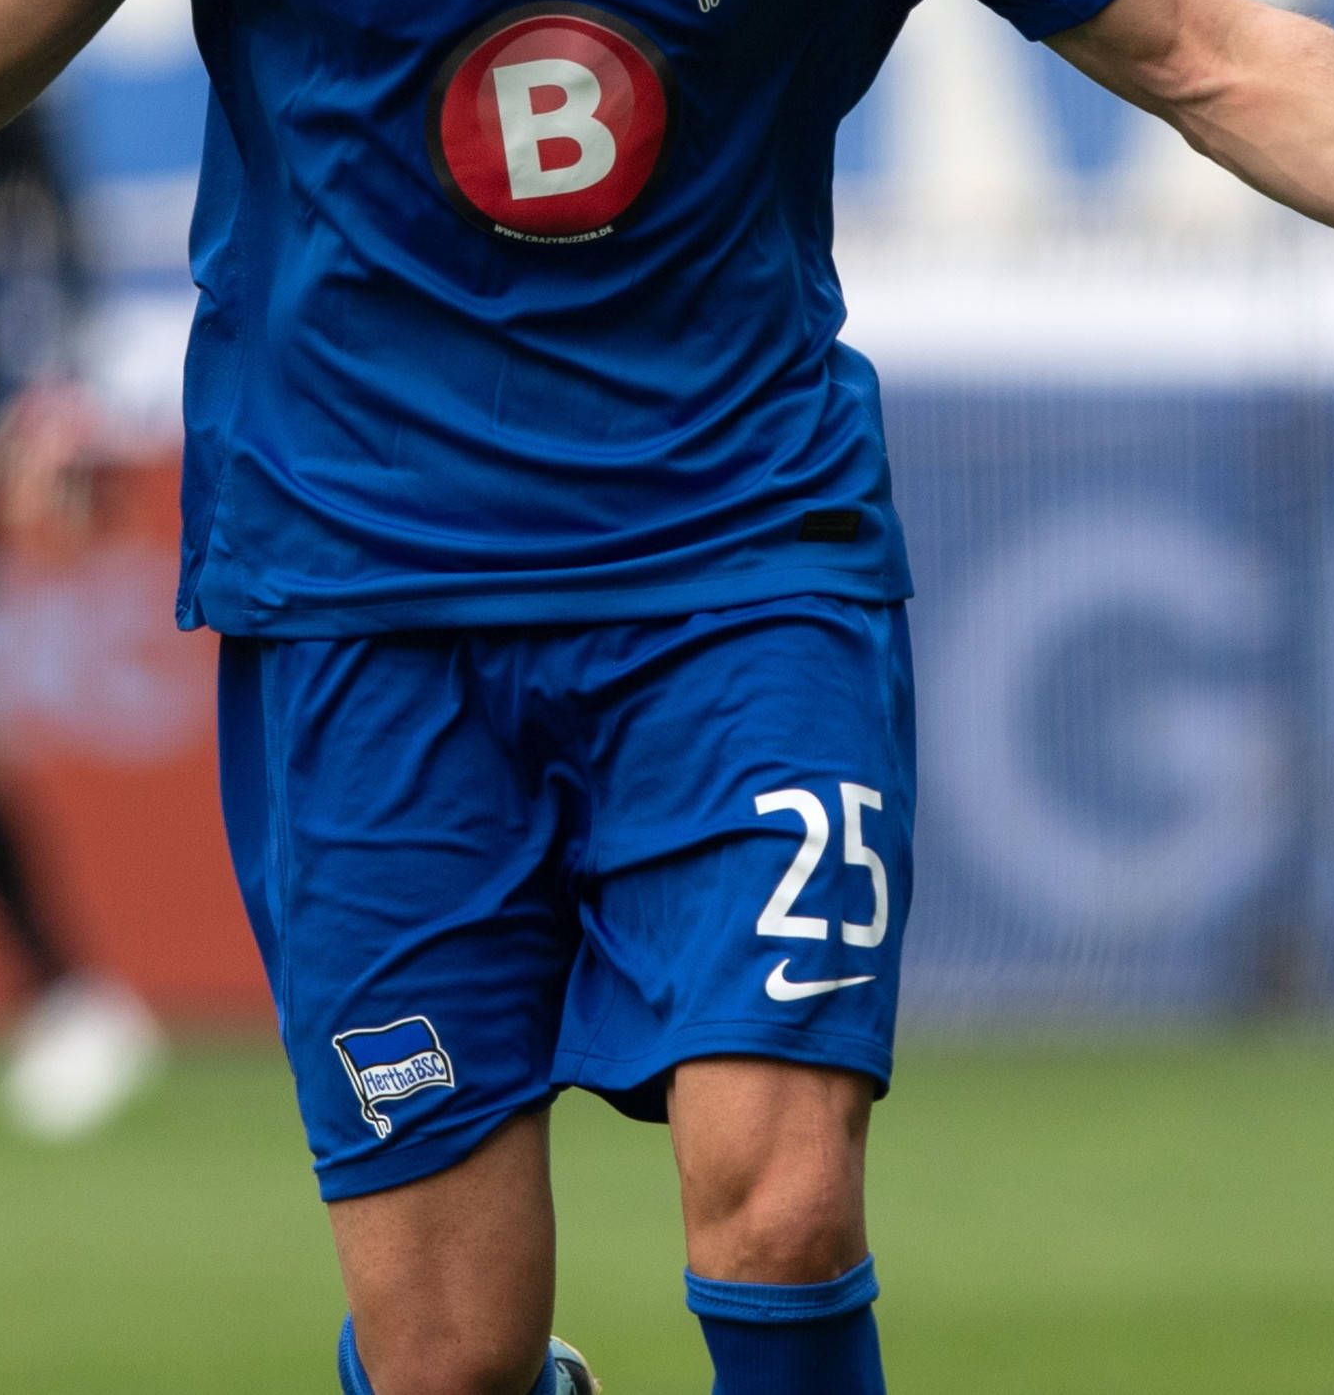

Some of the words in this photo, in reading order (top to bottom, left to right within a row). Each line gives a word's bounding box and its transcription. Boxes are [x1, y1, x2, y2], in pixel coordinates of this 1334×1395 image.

[493, 58, 616, 201] B
[754, 782, 888, 948] 25
[363, 1067, 415, 1094] Hertha
[411, 1053, 444, 1081] BSC
